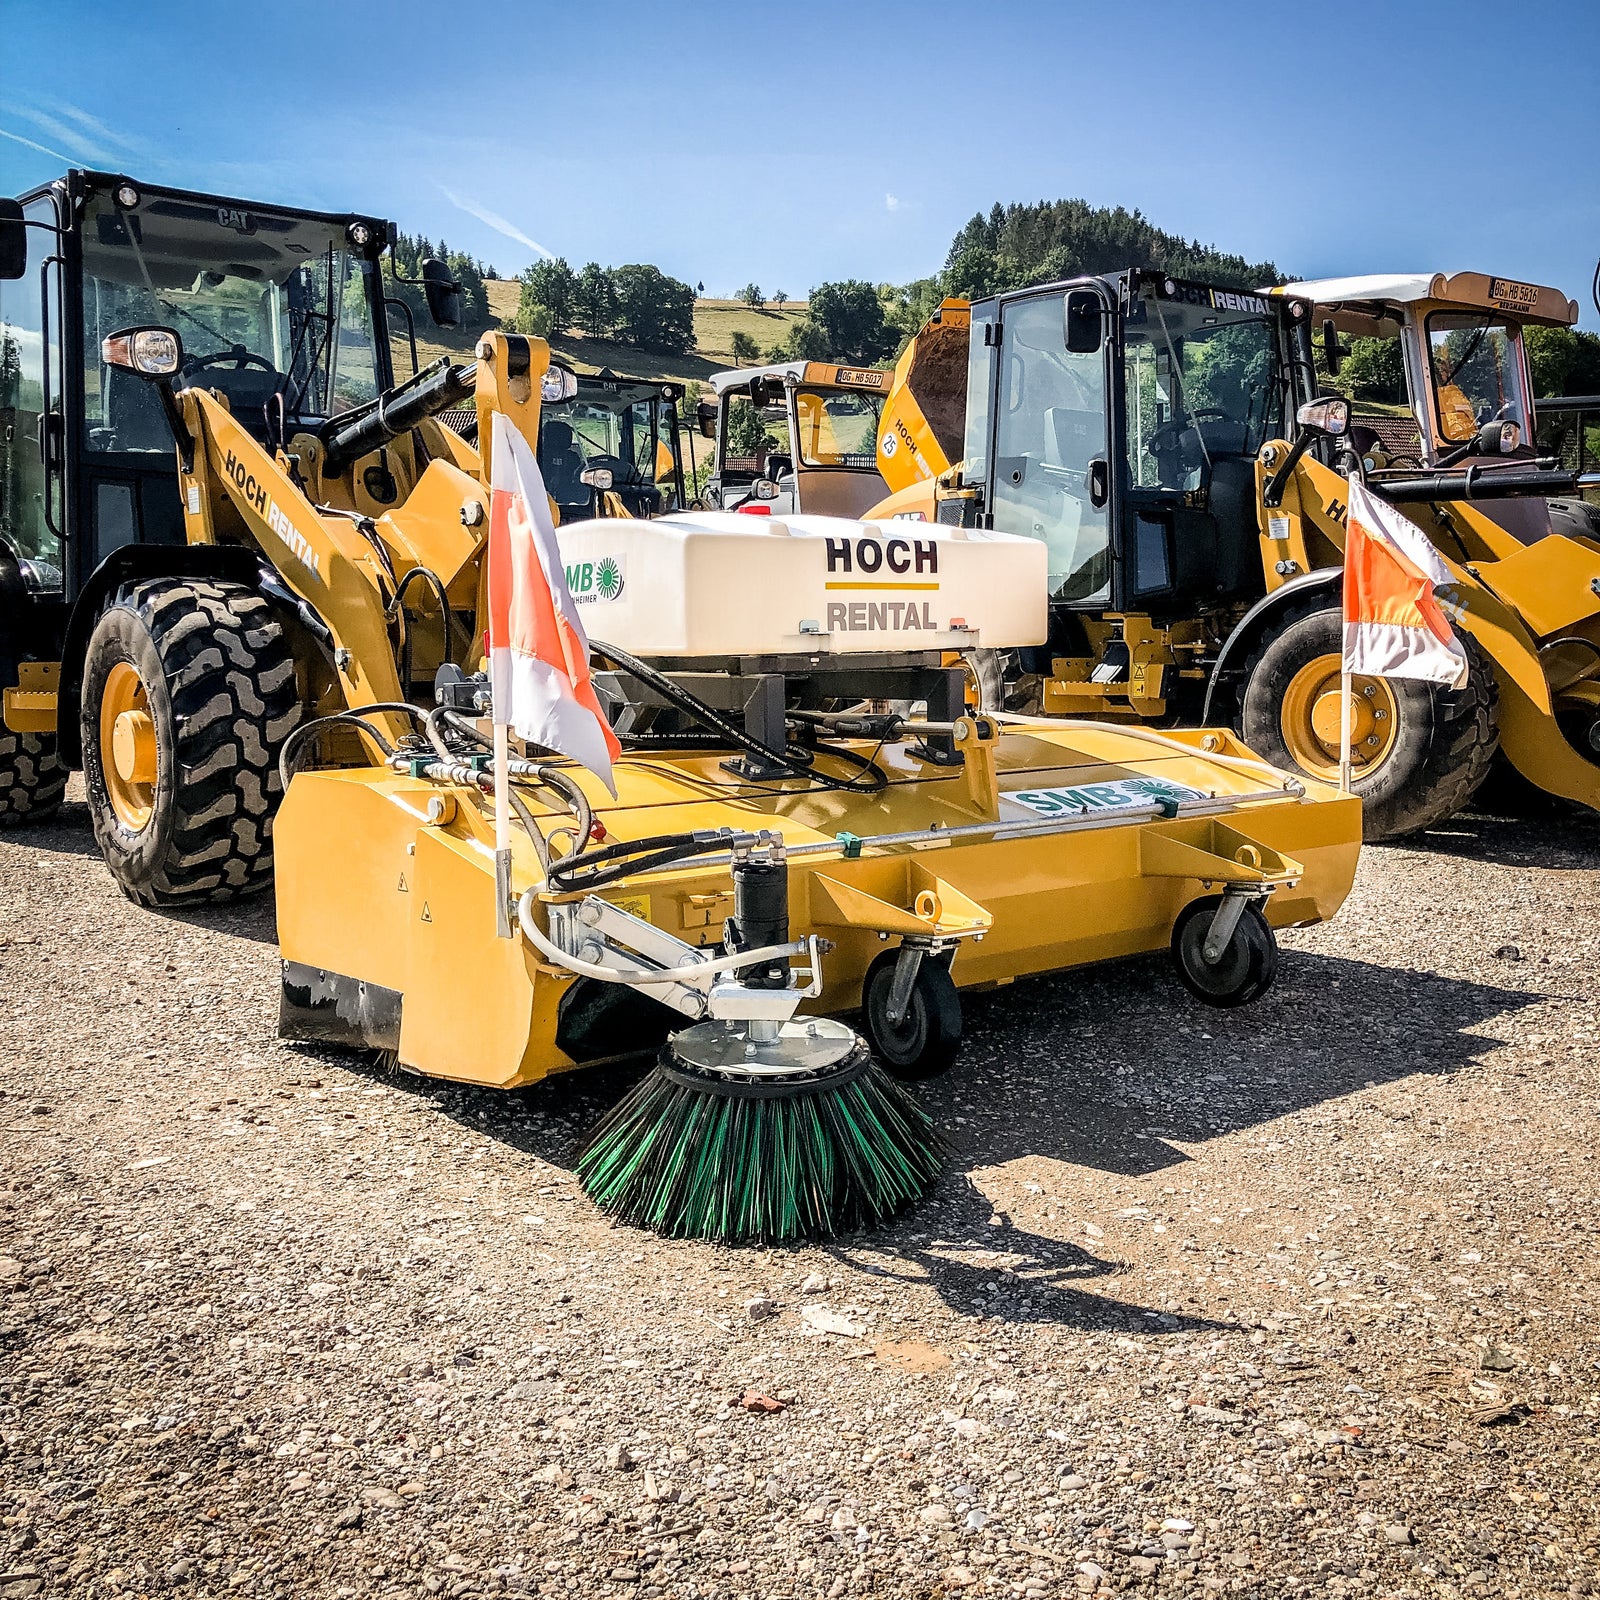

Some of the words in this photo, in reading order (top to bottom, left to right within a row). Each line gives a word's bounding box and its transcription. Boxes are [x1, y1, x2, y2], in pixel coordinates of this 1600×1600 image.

[218, 208, 248, 229] CAT
[1213, 291, 1275, 316] RENTAL
[883, 435, 896, 455] 25
[895, 418, 918, 455] HOCH
[225, 449, 267, 515] HOCH
[268, 500, 321, 584] RENTAL
[824, 537, 938, 573] HOCH
[826, 602, 938, 631] RENTAL
[1016, 786, 1132, 812] SMB
